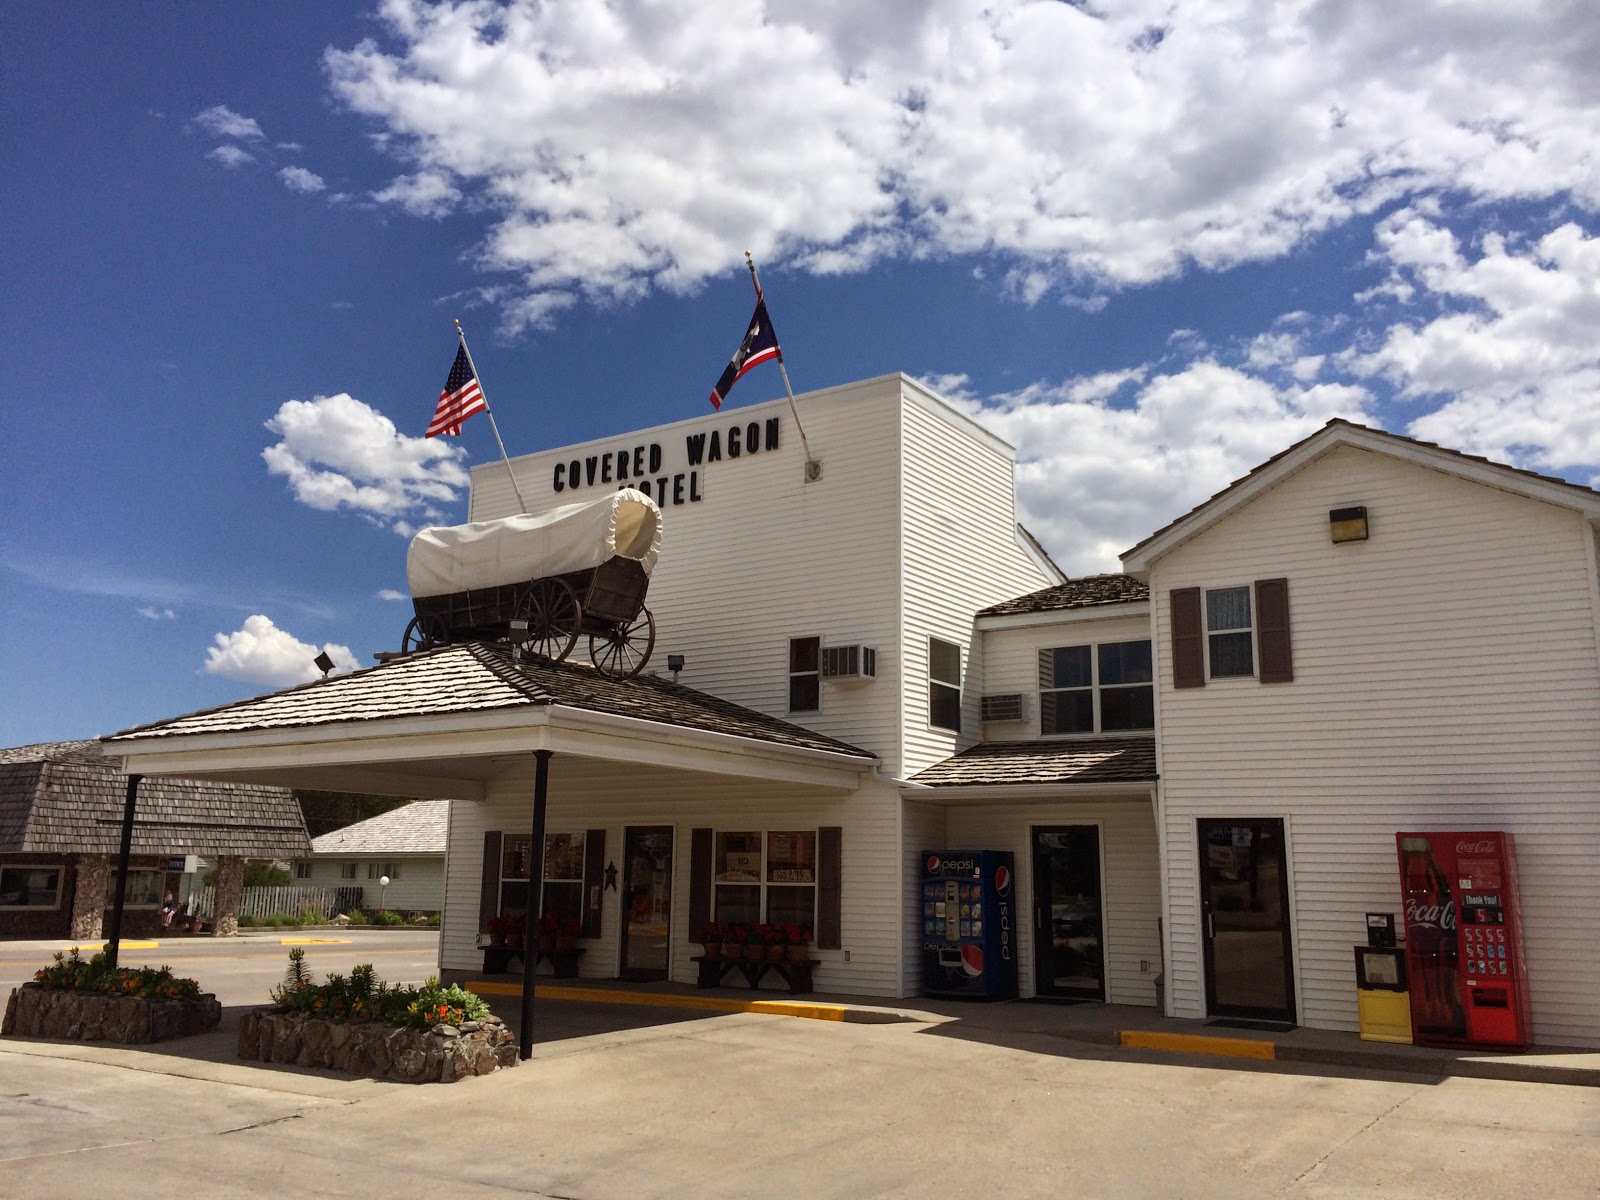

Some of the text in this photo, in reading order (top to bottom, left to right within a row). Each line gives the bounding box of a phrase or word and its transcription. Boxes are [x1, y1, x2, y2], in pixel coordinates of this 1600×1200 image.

[553, 417, 779, 492] COVERED WAGON
[618, 471, 702, 508] OTEL
[941, 858, 974, 871] pepsi
[999, 901, 1011, 960] pepsi
